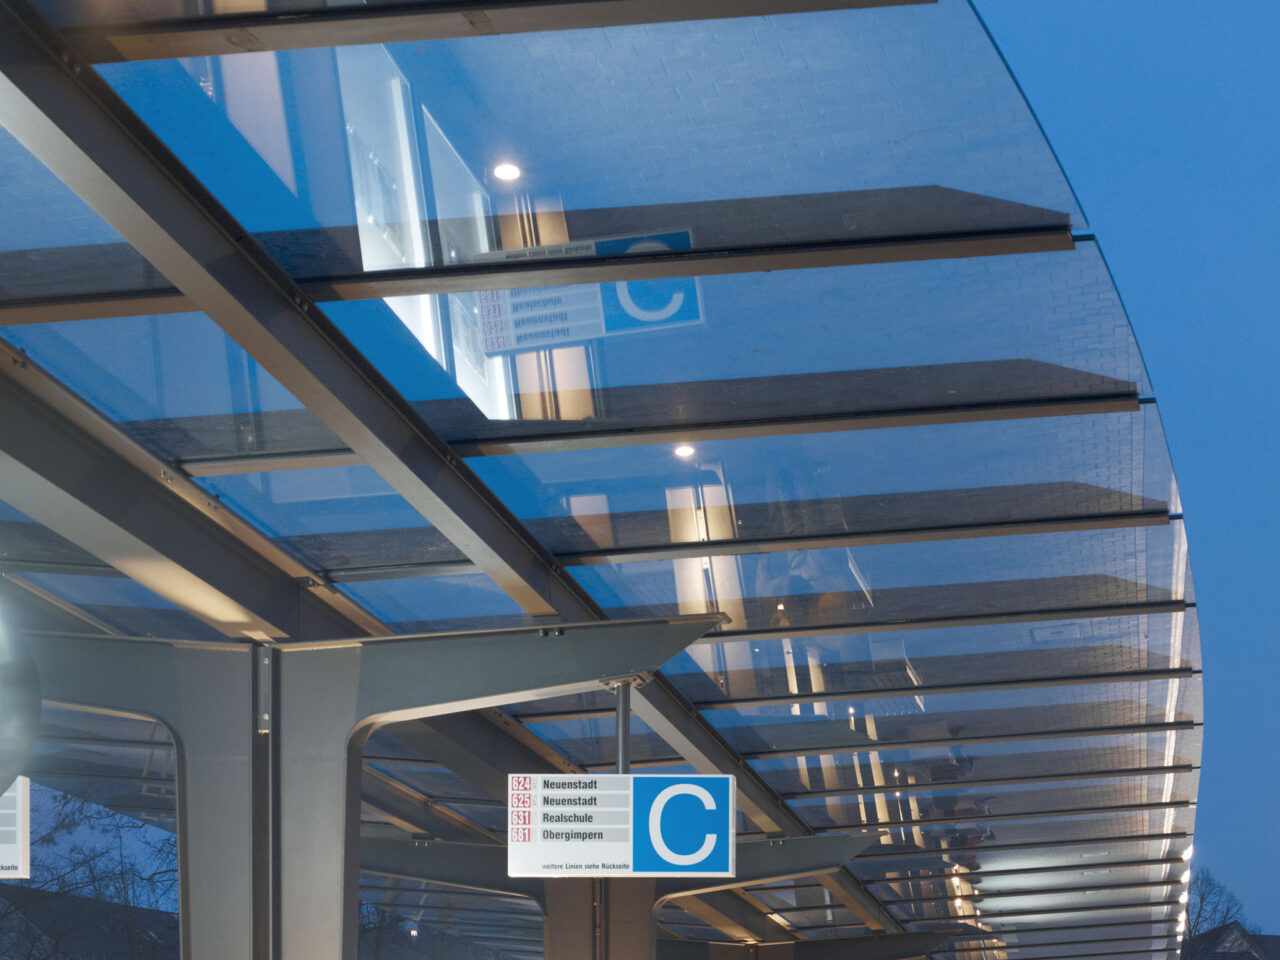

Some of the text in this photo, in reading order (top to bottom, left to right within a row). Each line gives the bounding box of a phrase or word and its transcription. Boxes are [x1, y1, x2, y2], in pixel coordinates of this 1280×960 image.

[512, 777, 598, 791] 624 Neuenstadt
[512, 794, 598, 808] 625 Neuenstadt
[512, 811, 594, 825] 631 Realschule
[649, 784, 717, 865] C
[543, 830, 603, 841] Obergimpern
